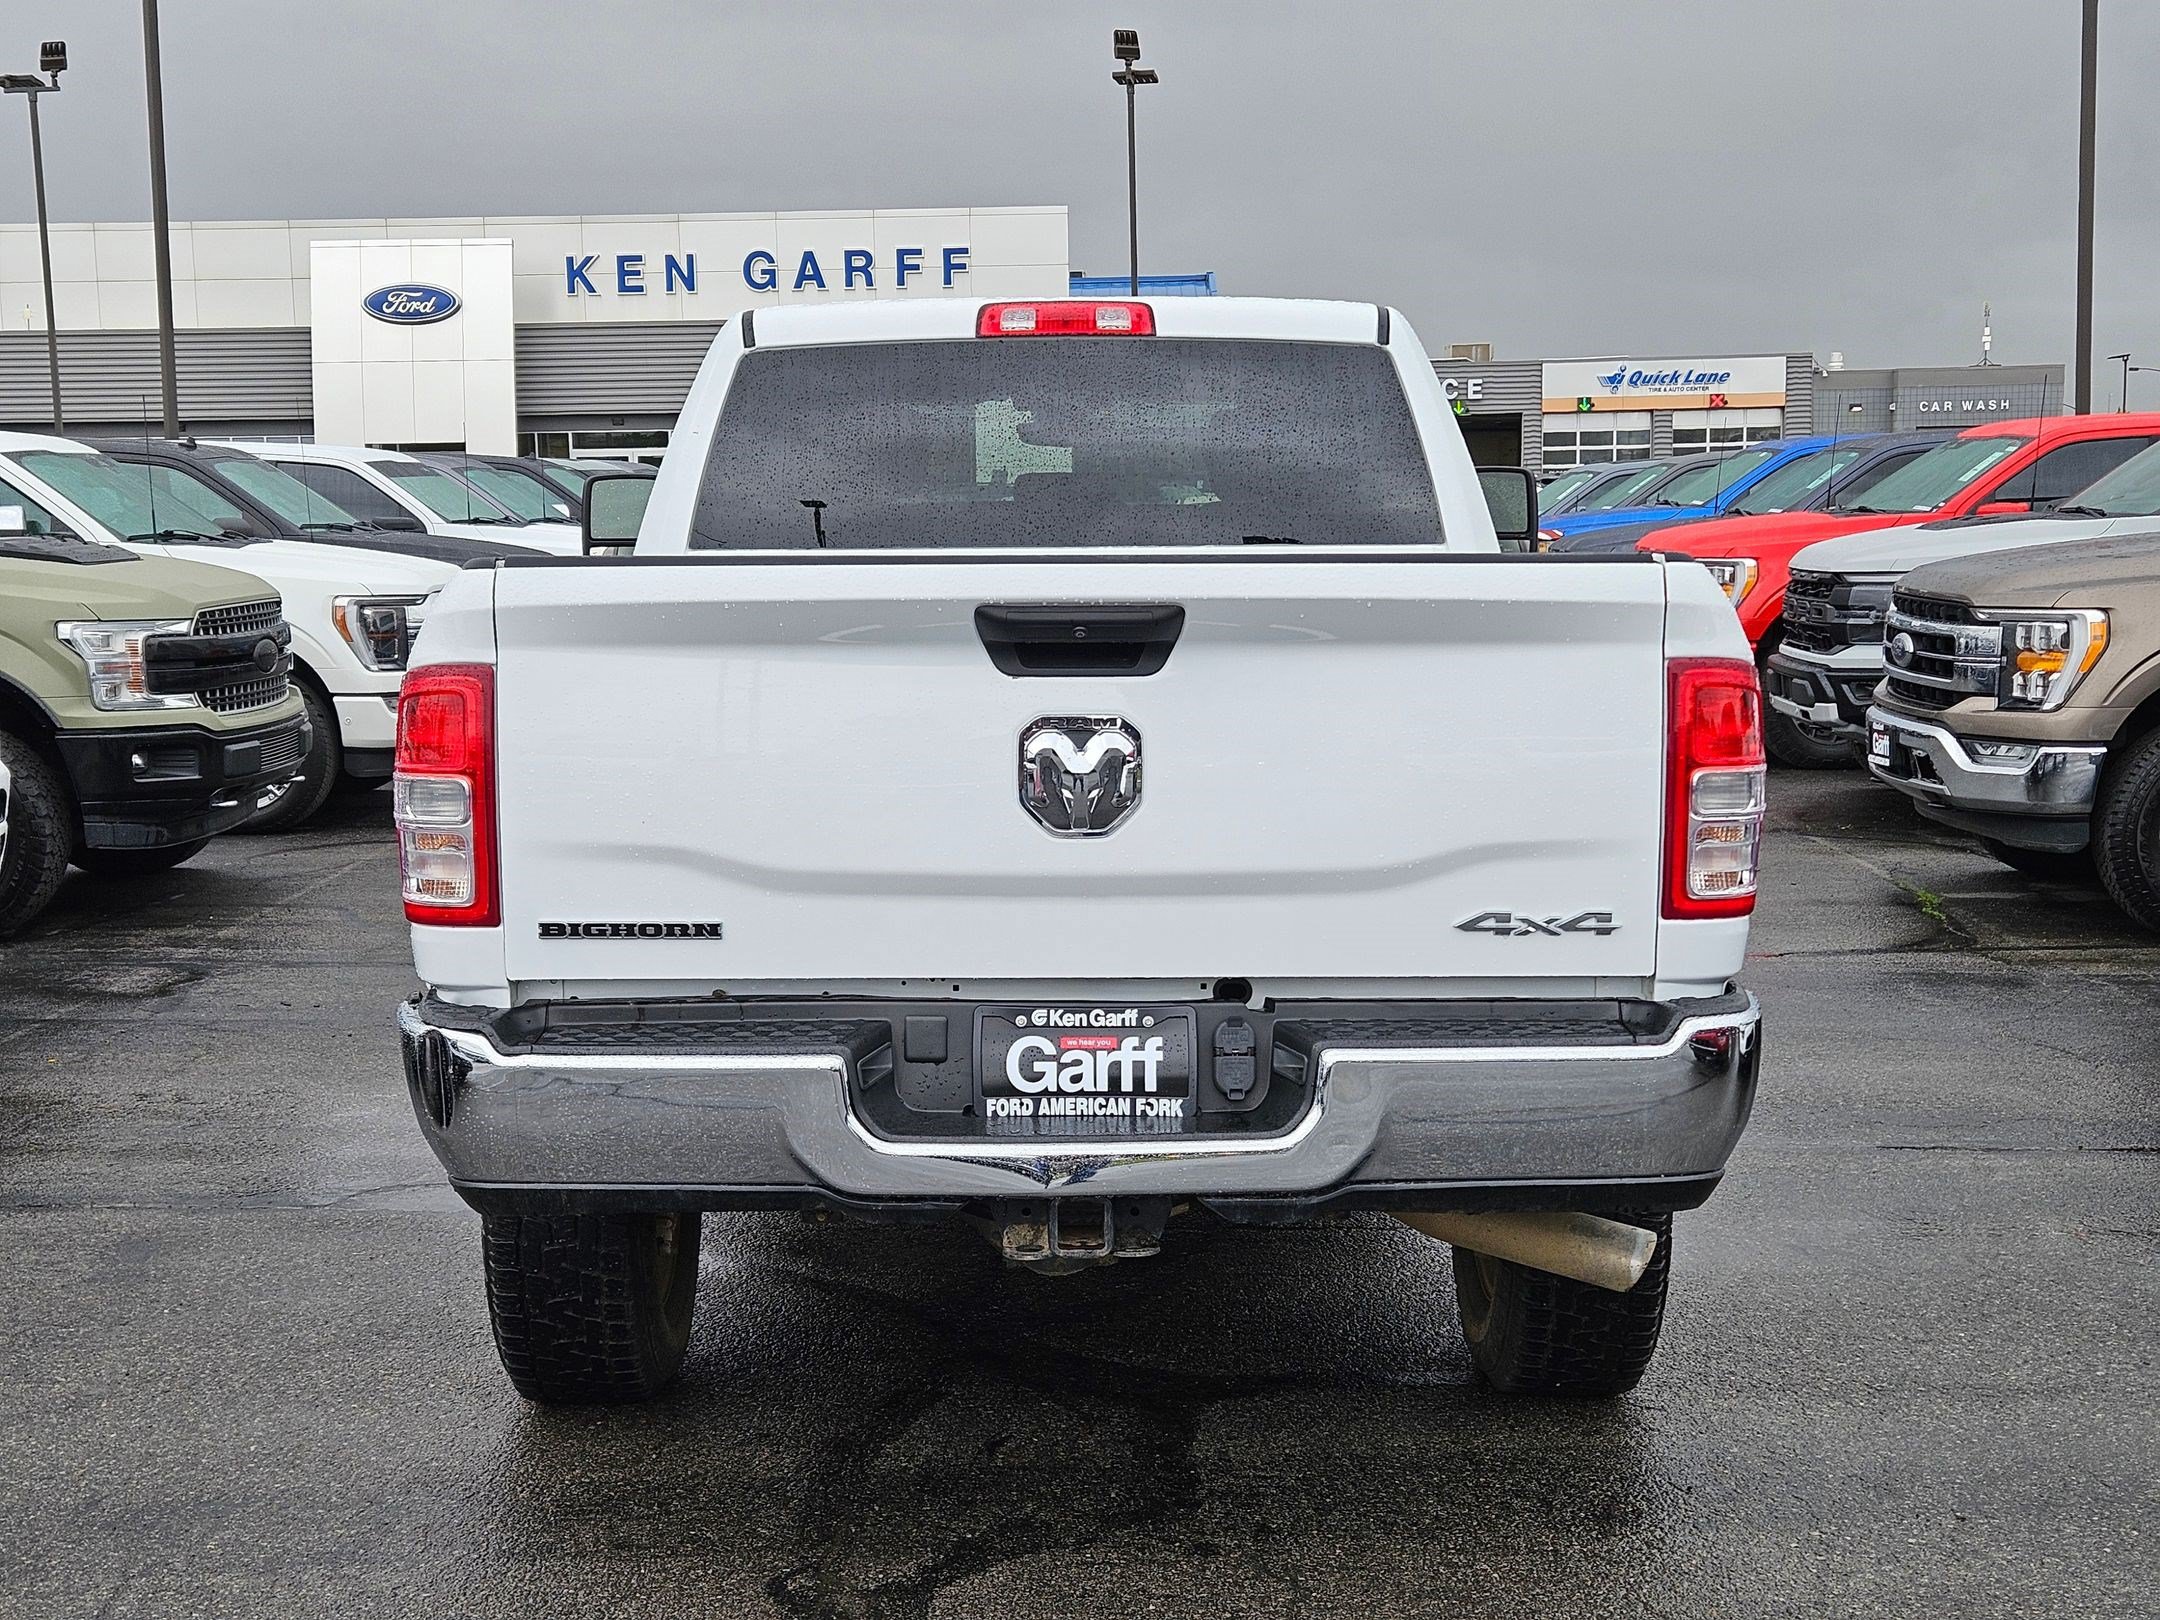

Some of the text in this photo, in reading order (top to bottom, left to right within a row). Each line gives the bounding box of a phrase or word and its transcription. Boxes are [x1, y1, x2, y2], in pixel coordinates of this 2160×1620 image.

[565, 246, 972, 296] KEN GARFF
[382, 291, 437, 313] Ford
[1627, 369, 1731, 388] Quick Lane
[1919, 399, 2010, 412] CAR WASH
[1043, 717, 1120, 729] RAM
[538, 921, 723, 940] BIGHORN
[1453, 911, 1623, 936] 4x4
[1049, 1008, 1139, 1027] Ken Garff
[1078, 1038, 1095, 1046] hear
[1005, 1035, 1164, 1093] Garff
[986, 1098, 1183, 1117] FORD AMERICAN FORK
